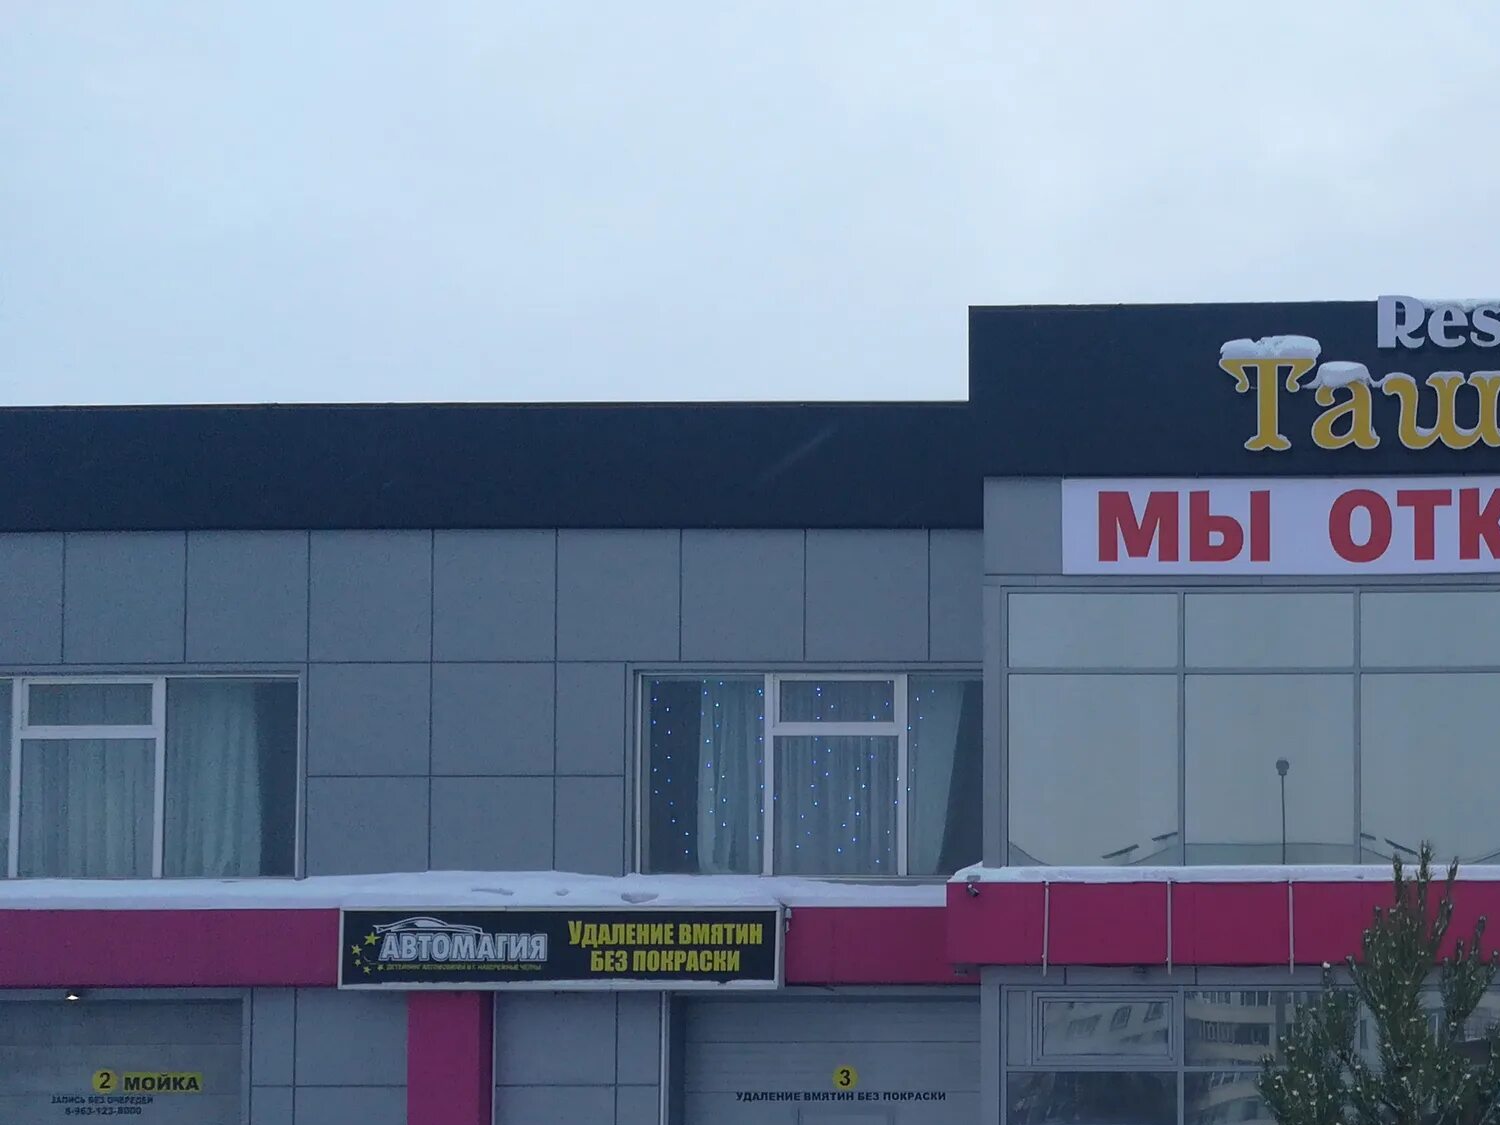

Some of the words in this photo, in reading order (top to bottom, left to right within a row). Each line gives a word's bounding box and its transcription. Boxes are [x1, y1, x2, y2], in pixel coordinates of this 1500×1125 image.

[1098, 490, 1270, 562] МЫ
[678, 923, 763, 945] ВМЯТИН
[379, 933, 548, 961] АВТОМАГИЯ
[590, 950, 628, 972] БЕЗ
[632, 950, 741, 972] ПОКРАСКИ
[99, 1072, 111, 1089] 2
[124, 1073, 200, 1091] МОЙКА
[839, 1069, 851, 1087] 3
[736, 1092, 801, 1102] УДАЛЕНИЕ
[804, 1092, 854, 1101] ВМЯТИН
[857, 1092, 879, 1101] БЕЗ
[883, 1092, 946, 1101] ПОКРАСКИ
